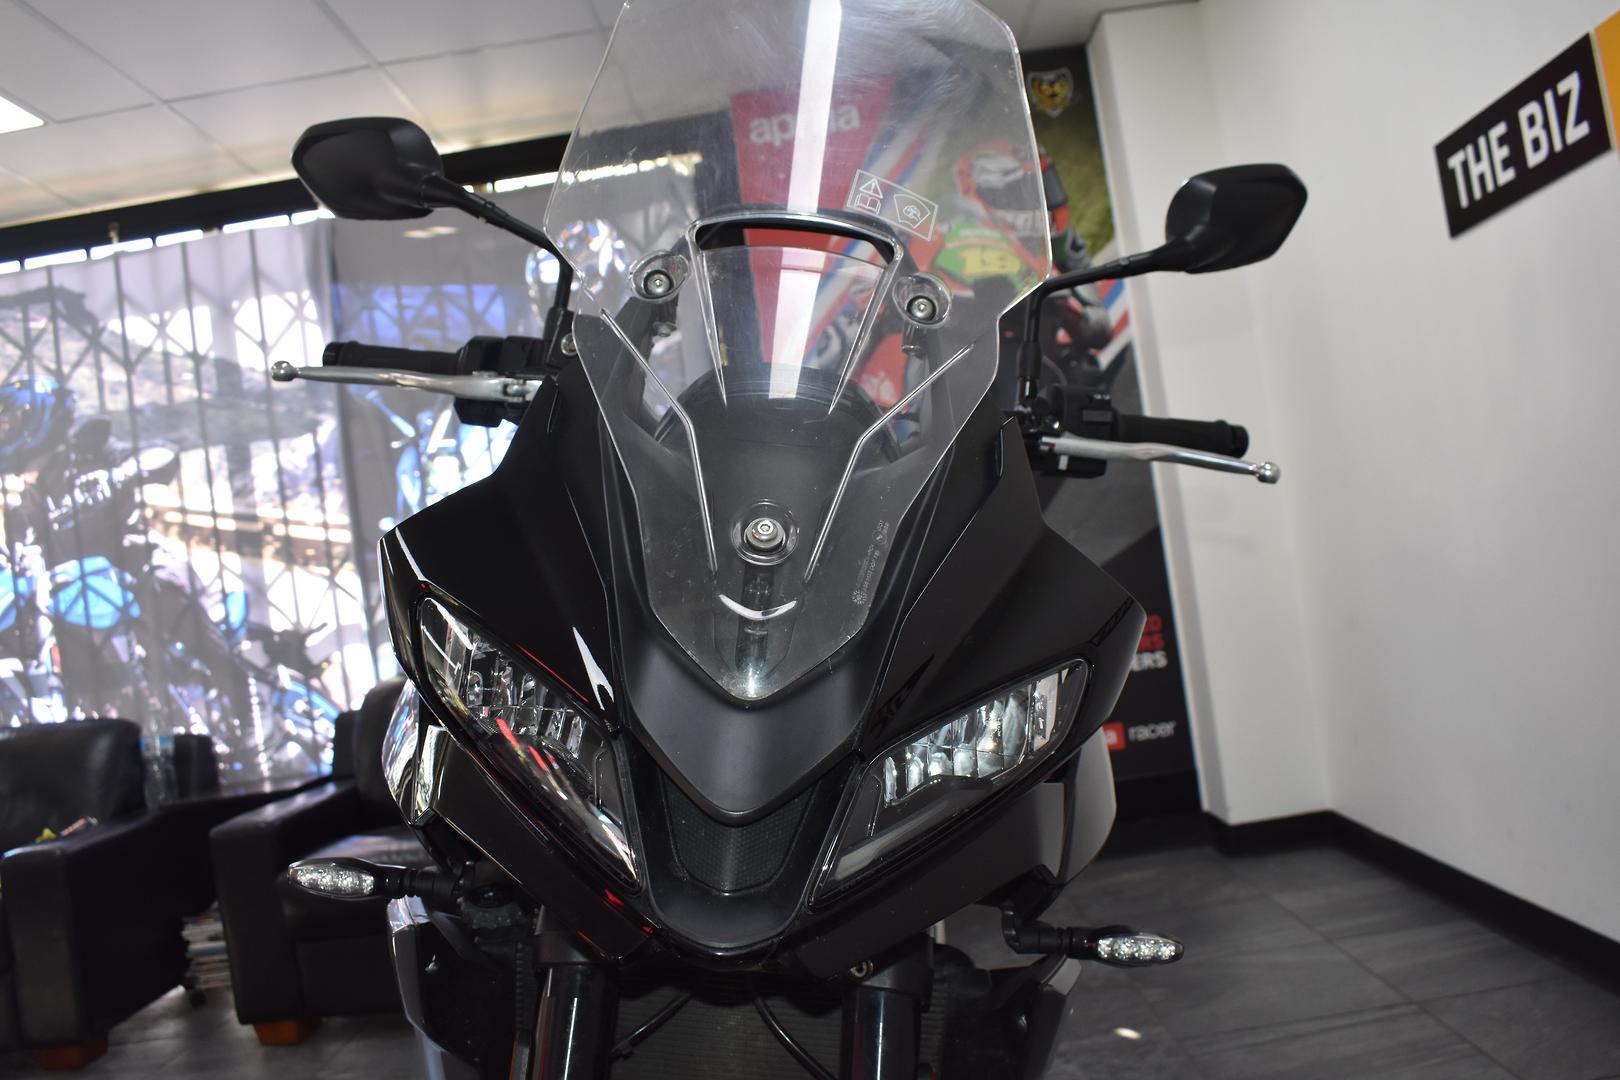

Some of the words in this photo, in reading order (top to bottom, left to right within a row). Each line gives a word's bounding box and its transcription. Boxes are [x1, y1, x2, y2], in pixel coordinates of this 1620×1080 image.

[750, 105, 860, 146] apia
[1447, 120, 1516, 209] THE
[1518, 70, 1590, 169] BIZ
[1130, 650, 1168, 671] ERS
[1128, 721, 1176, 742] racer
